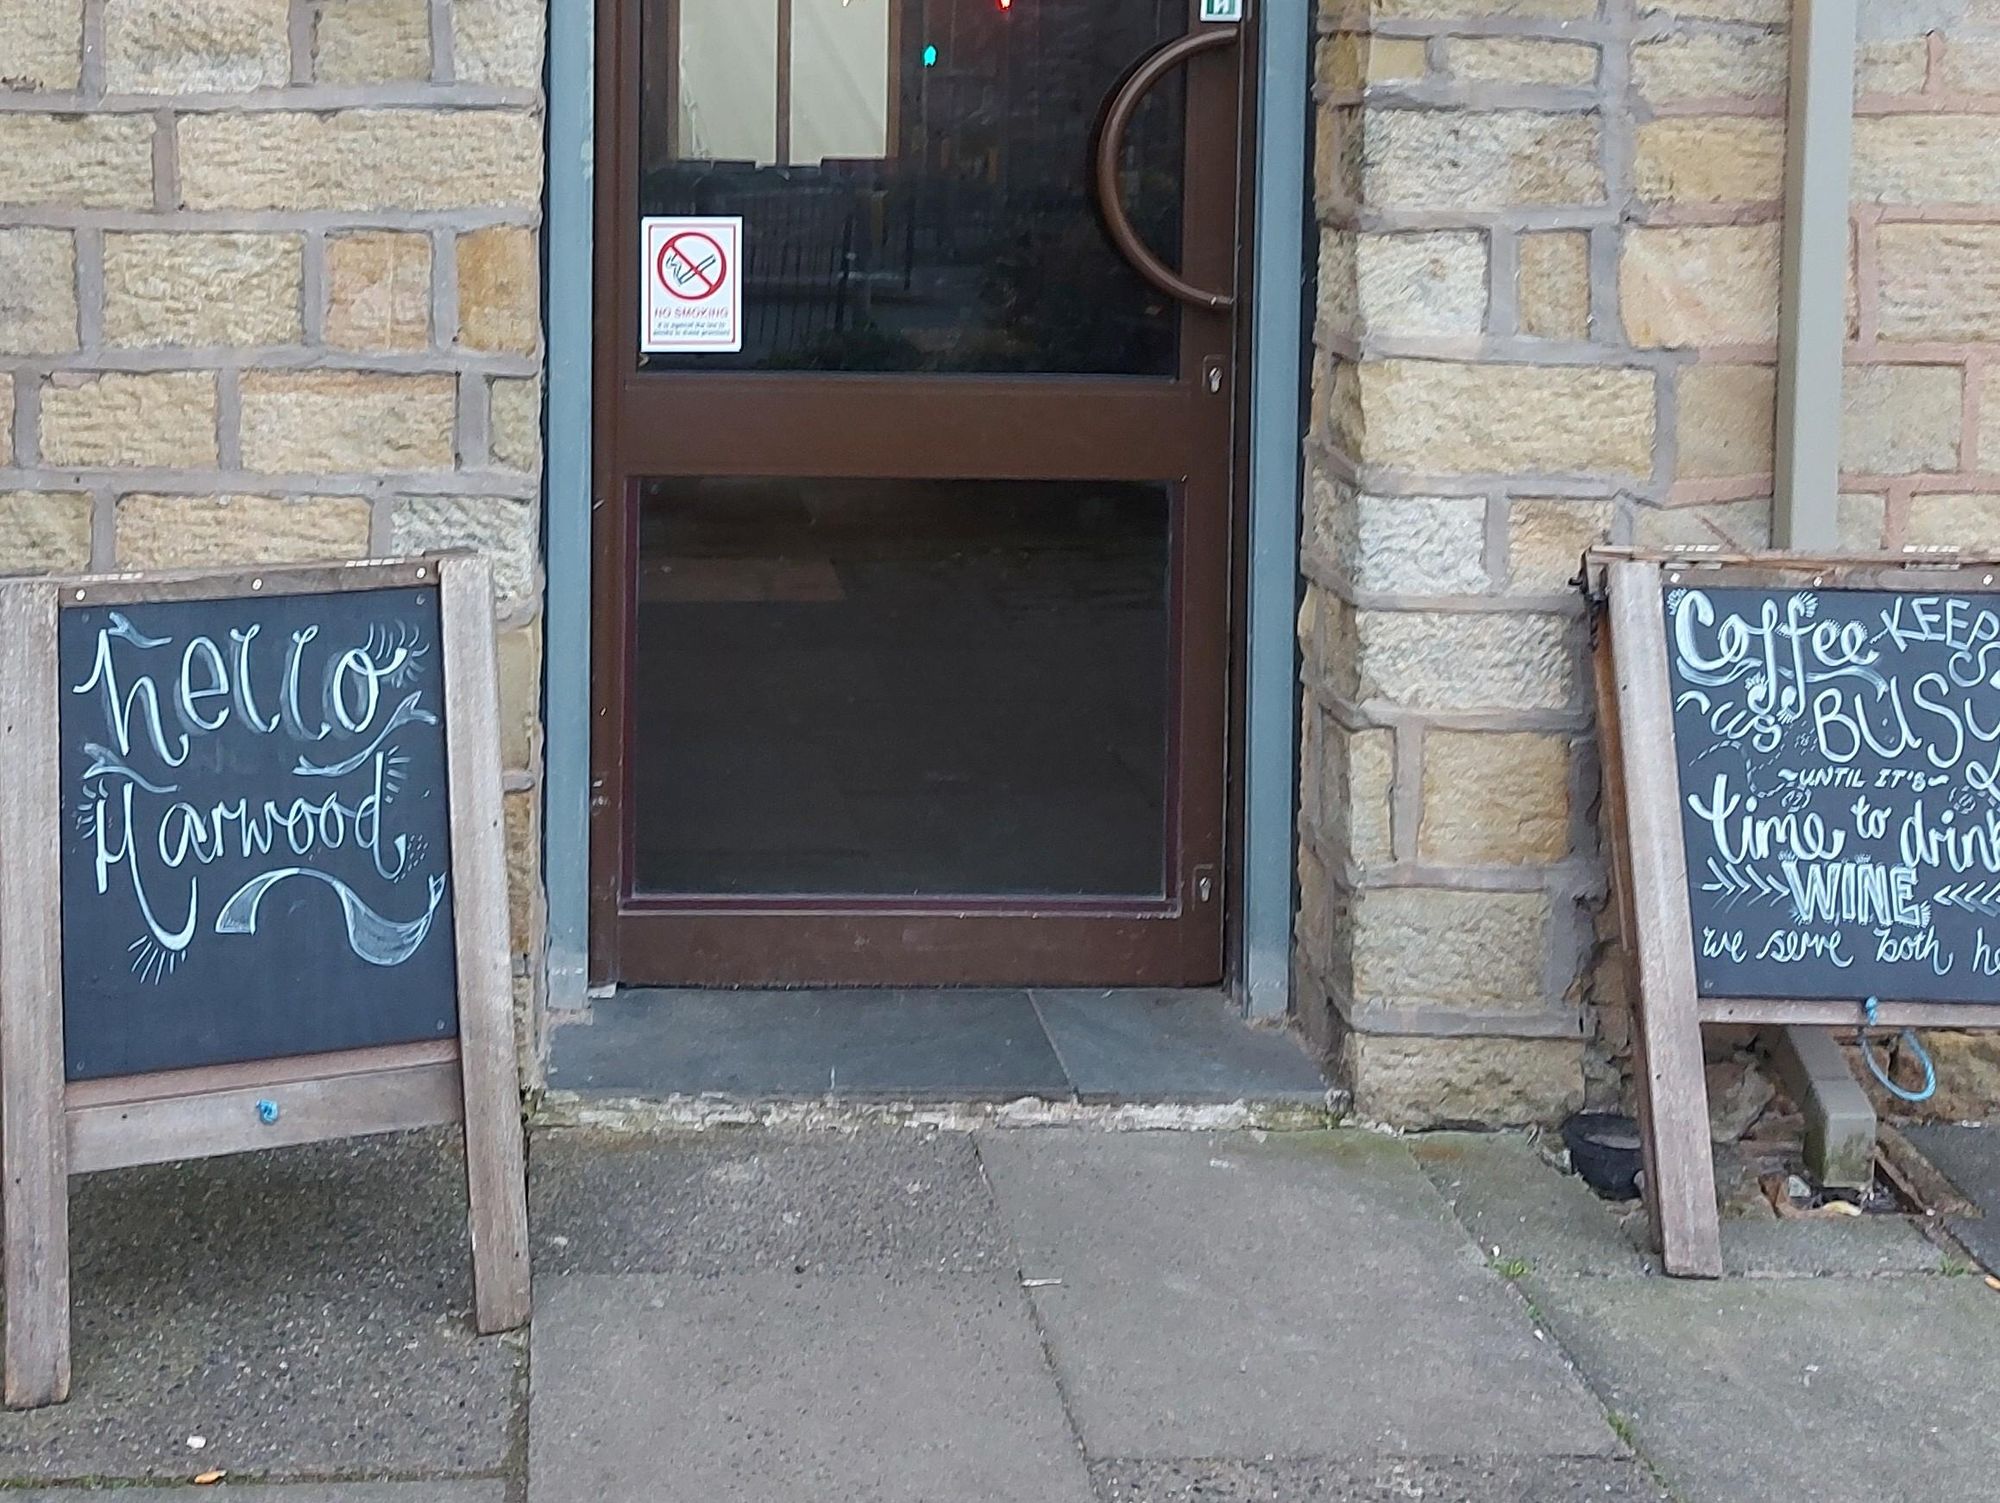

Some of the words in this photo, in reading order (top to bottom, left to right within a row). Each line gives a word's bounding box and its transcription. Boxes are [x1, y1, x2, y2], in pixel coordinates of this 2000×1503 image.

[654, 307, 672, 319] NO
[674, 306, 729, 320] SMOKING
[1675, 590, 1879, 720] Coffee
[1799, 765, 1866, 788] UNTIL
[1874, 767, 1926, 793] IT'S
[95, 752, 407, 951] Harwood
[1688, 774, 1846, 864] time
[1851, 795, 1892, 839] to
[1782, 860, 1923, 926] WINE
[1702, 926, 1747, 963] we
[1756, 929, 1855, 968] serve
[1873, 925, 1953, 976] both
